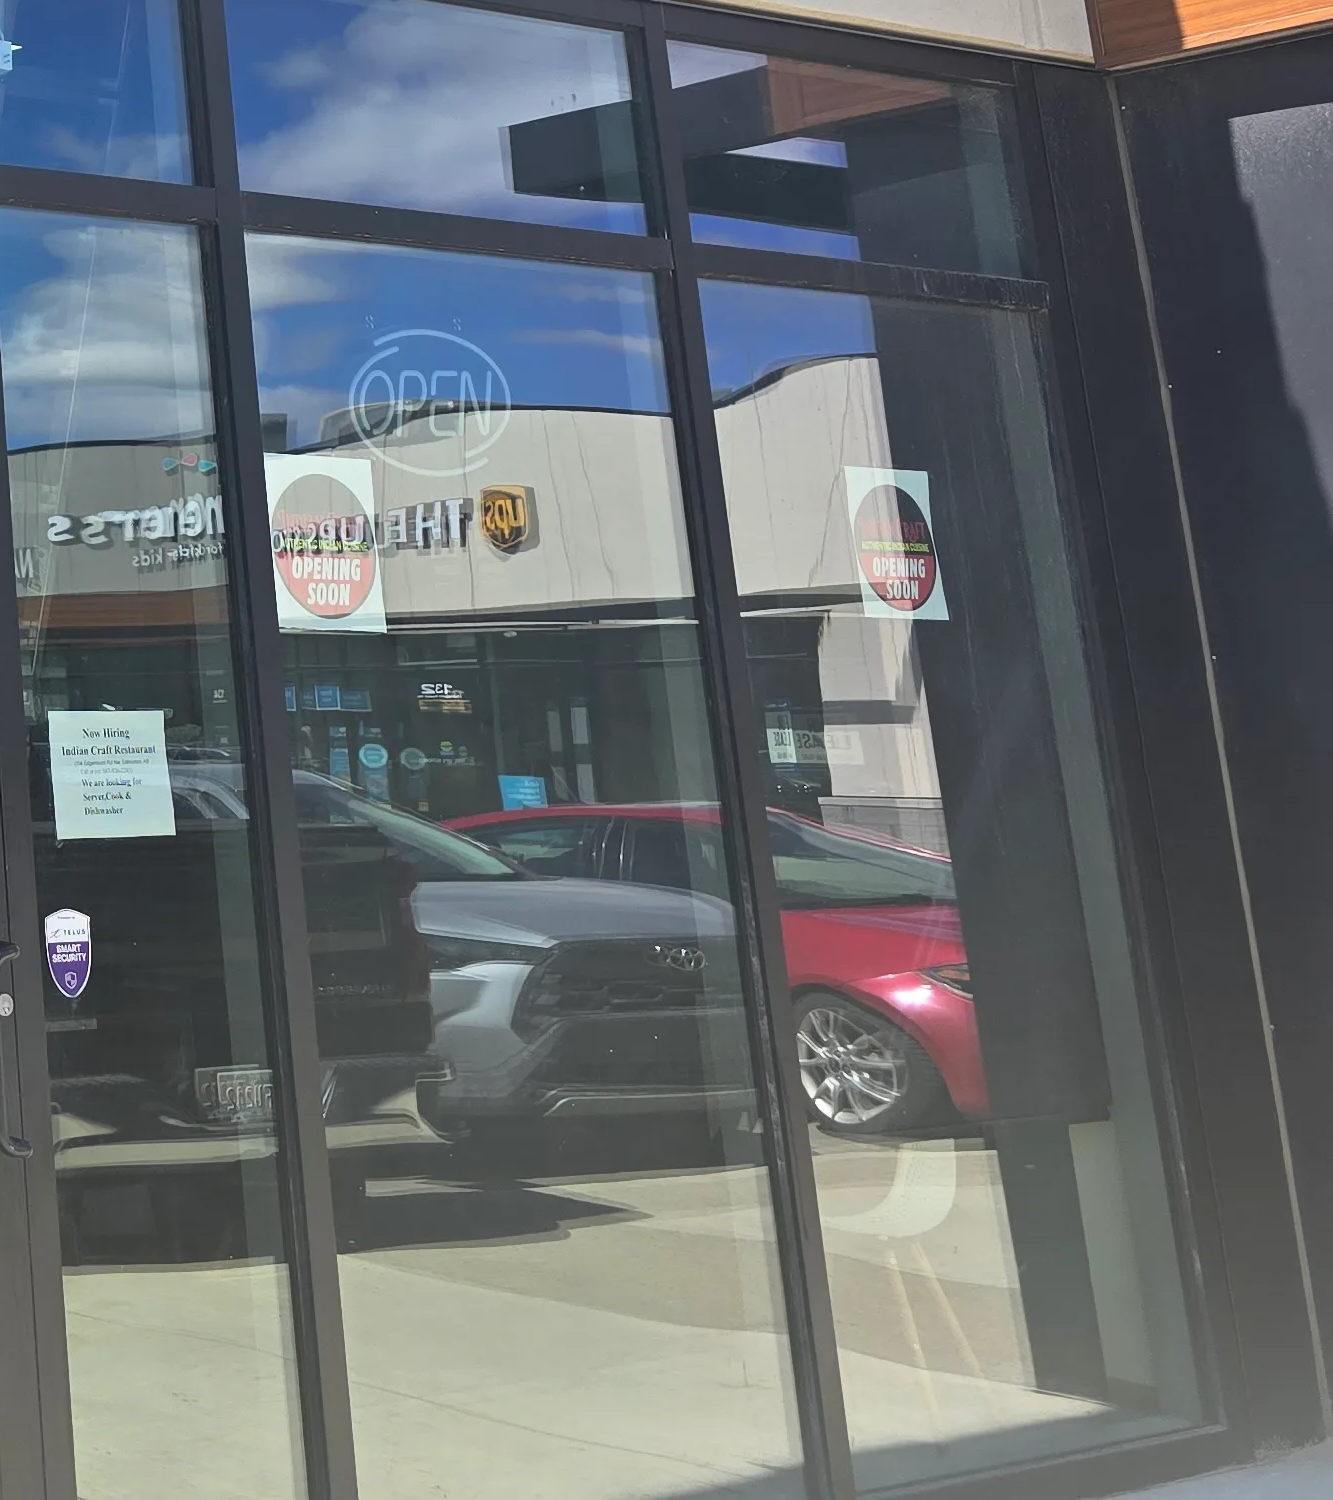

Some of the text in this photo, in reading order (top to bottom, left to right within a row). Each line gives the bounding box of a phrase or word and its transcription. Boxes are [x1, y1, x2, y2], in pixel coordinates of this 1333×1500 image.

[359, 369, 492, 438] OPEN
[291, 555, 361, 581] OPENING
[872, 556, 926, 579] OPENING
[307, 582, 351, 606] SOON
[886, 579, 919, 600] SOON
[82, 727, 130, 739] Now Hiring
[61, 744, 156, 756] Indian Craft Restaurant
[81, 778, 94, 787] We
[94, 779, 104, 787] are
[105, 777, 132, 788] looking
[84, 806, 124, 816] Dishwasher
[63, 928, 86, 936] TELUS
[56, 943, 82, 953] SMART
[52, 952, 87, 963] SECURITY
